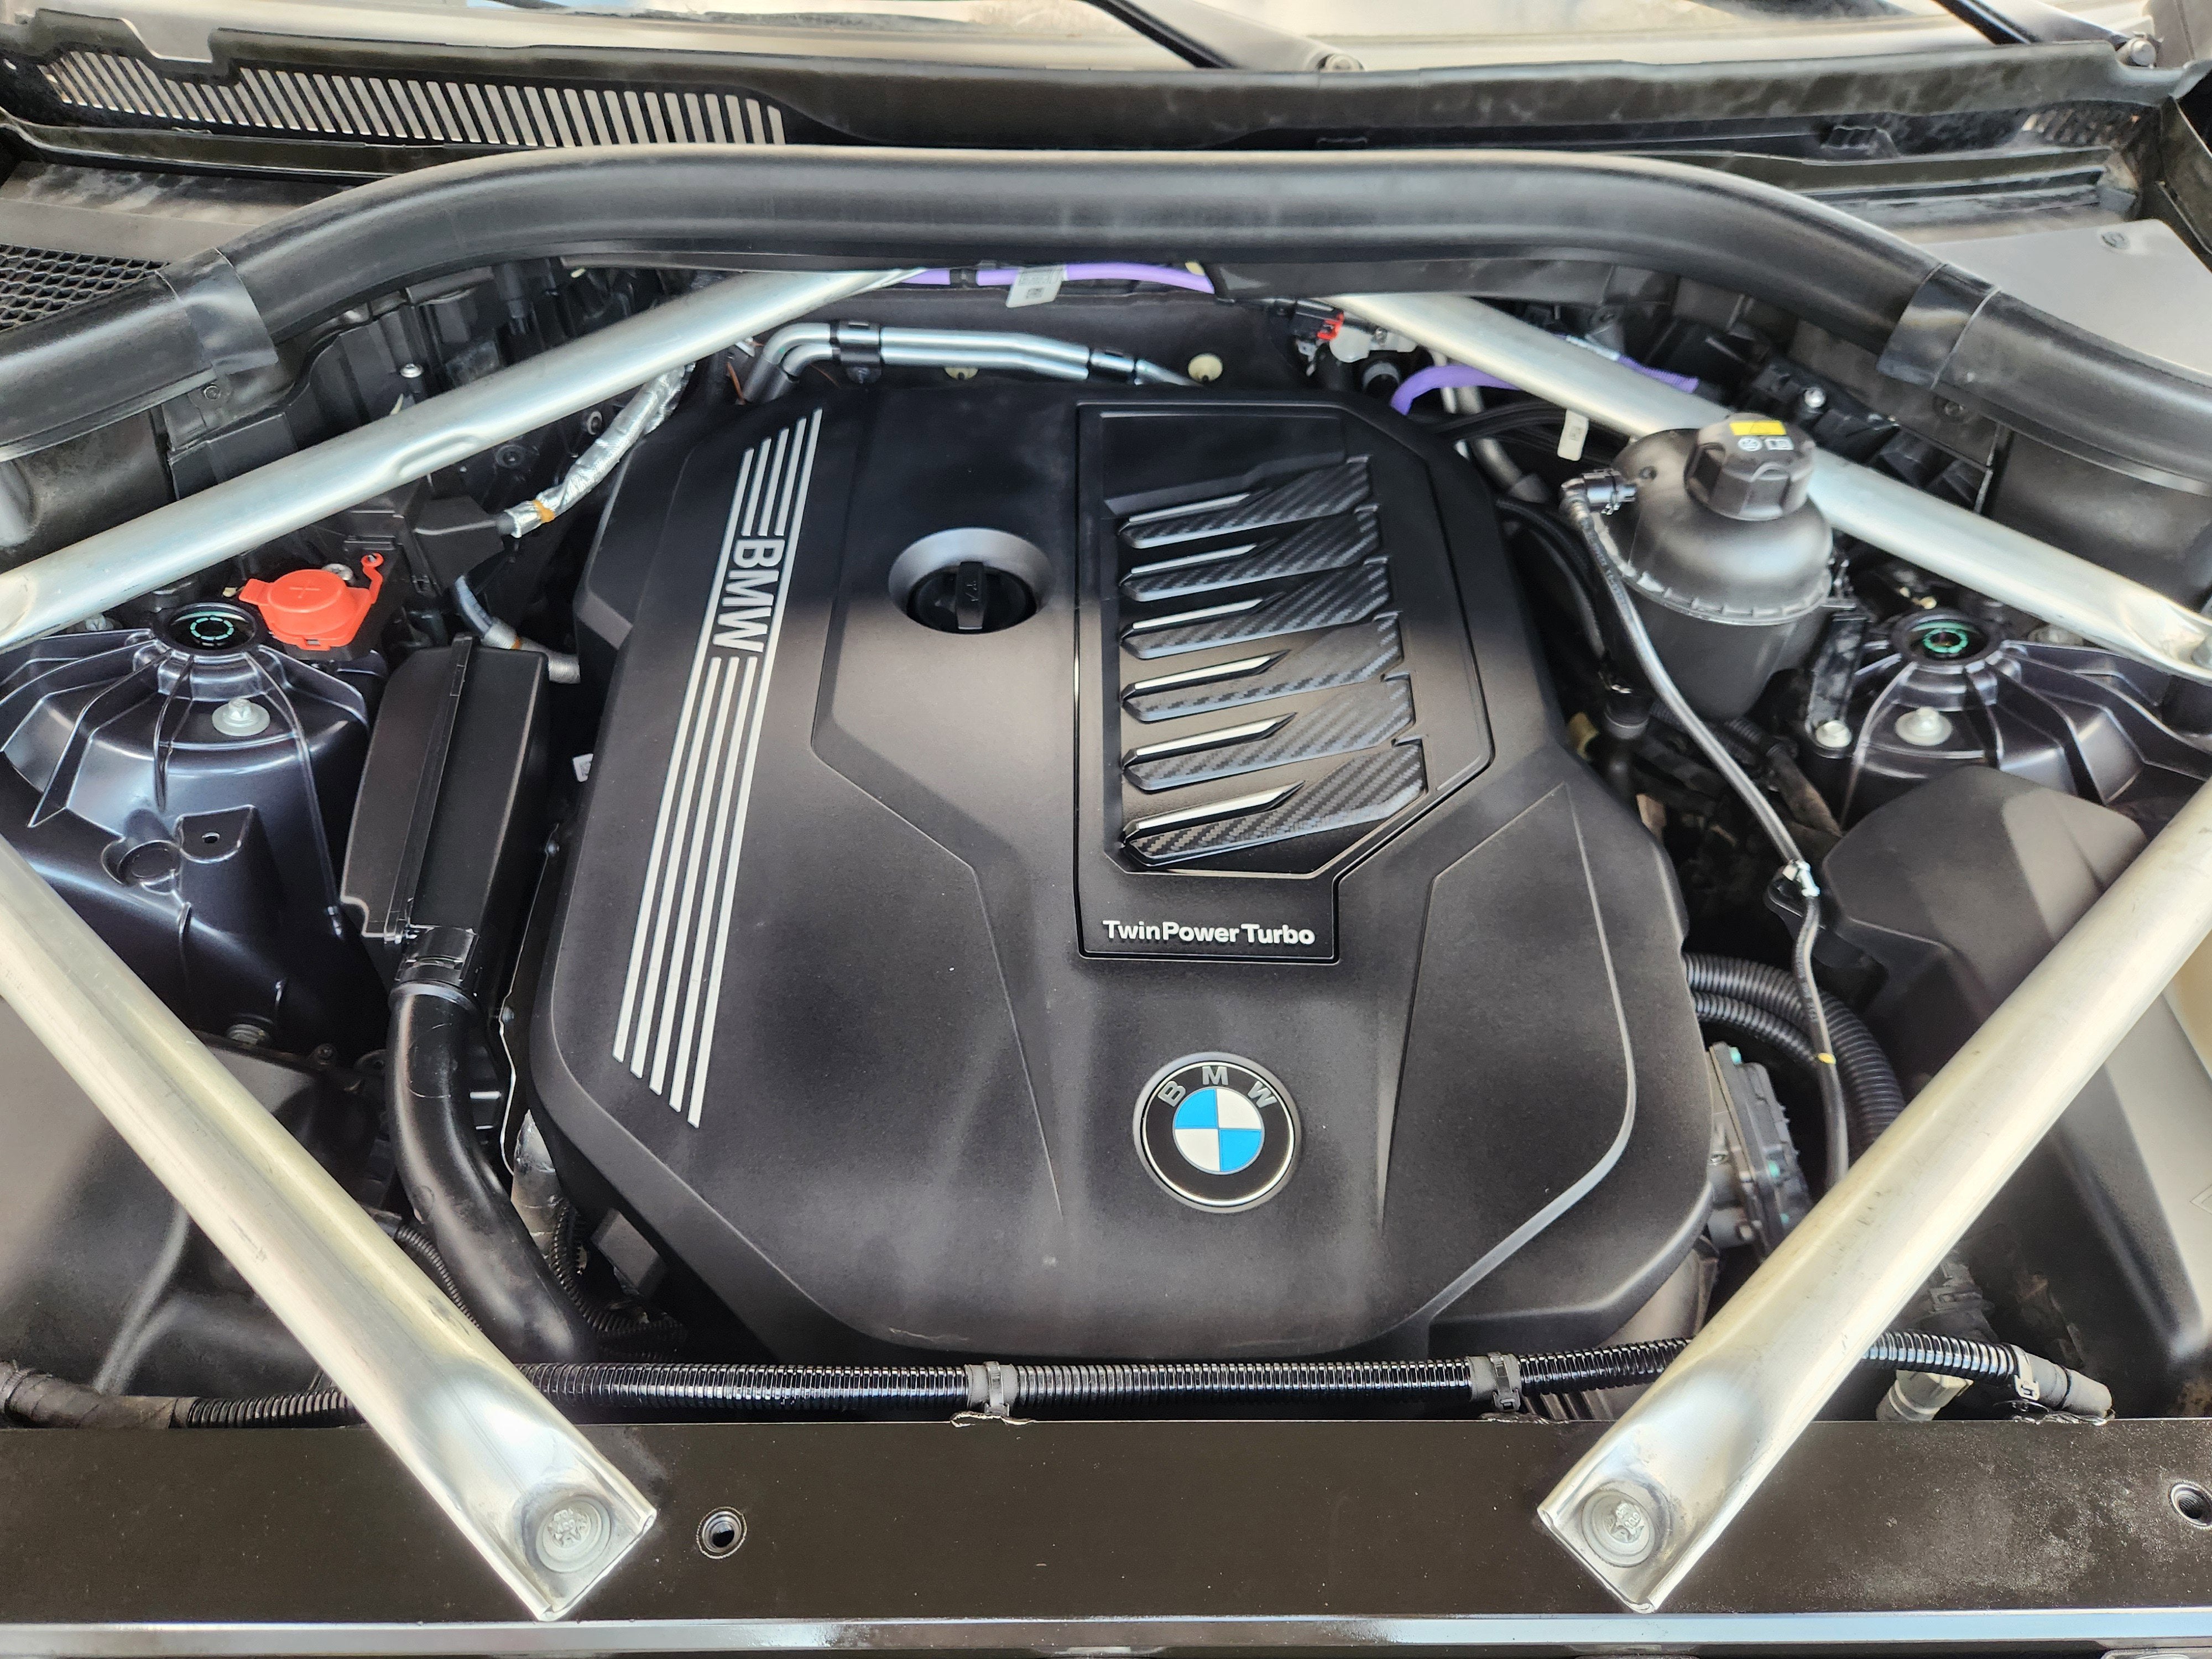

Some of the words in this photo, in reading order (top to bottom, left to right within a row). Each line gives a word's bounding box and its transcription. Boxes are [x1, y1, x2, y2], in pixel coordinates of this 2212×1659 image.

[712, 539, 785, 653] BMW
[1240, 923, 1316, 945] Turbo
[1157, 1066, 1277, 1108] BMW
